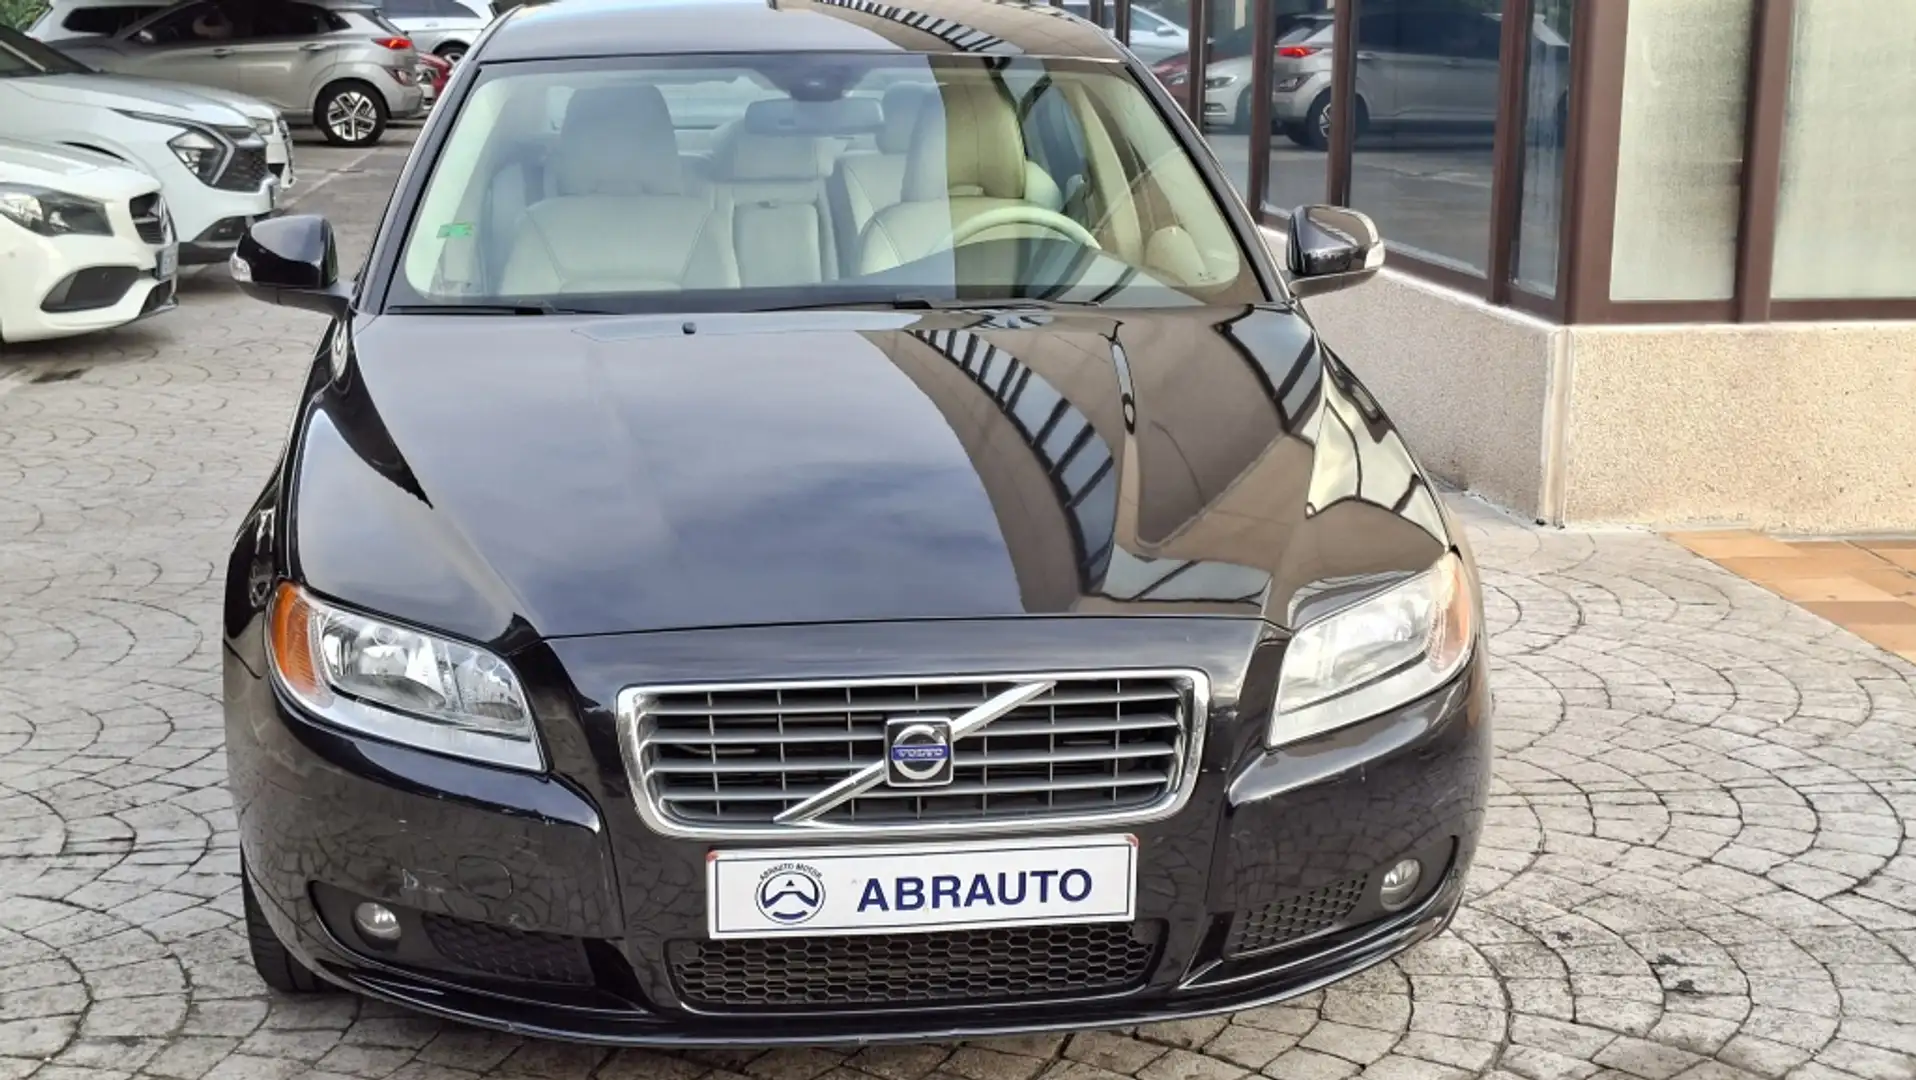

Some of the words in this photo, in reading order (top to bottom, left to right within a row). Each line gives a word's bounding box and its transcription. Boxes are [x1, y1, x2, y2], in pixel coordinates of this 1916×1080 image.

[896, 748, 944, 758] VOLVO
[796, 862, 823, 879] MOTOR
[857, 868, 1092, 913] ABRAUTO
